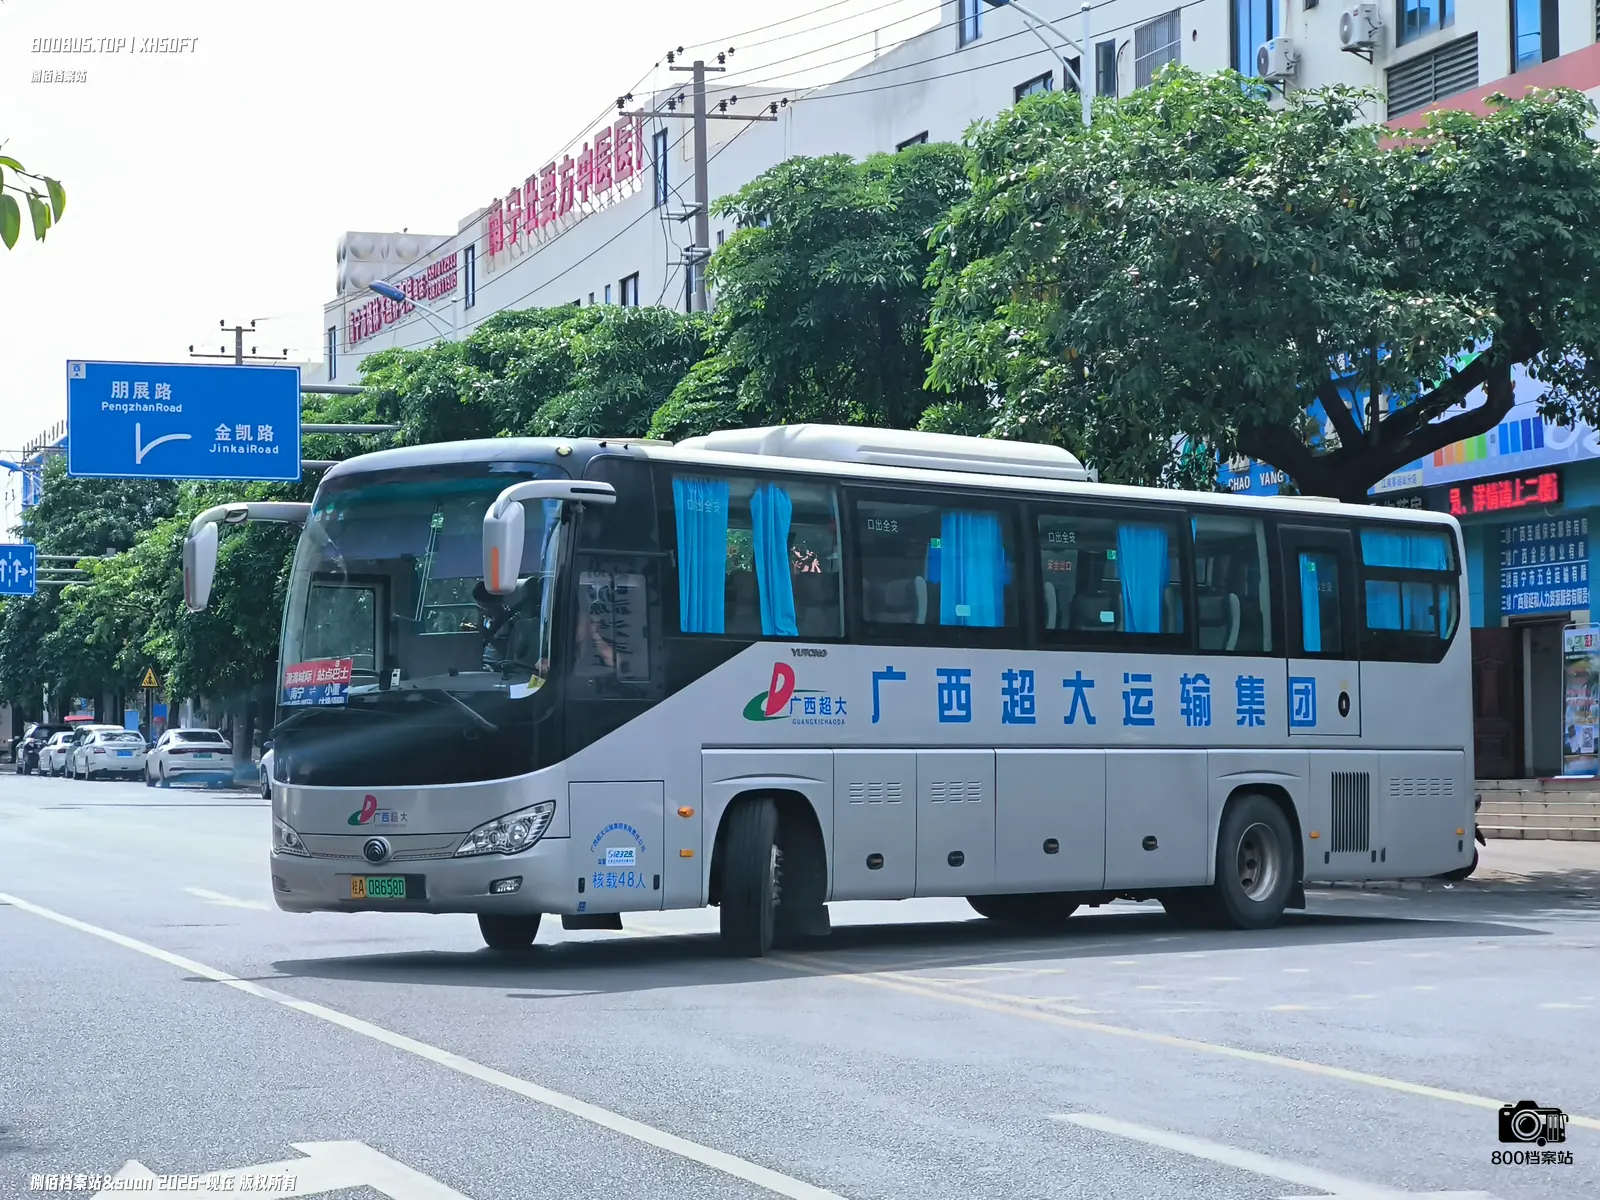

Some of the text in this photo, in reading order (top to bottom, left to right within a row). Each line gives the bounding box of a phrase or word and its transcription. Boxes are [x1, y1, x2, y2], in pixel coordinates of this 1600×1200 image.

[111, 381, 173, 401] 朋展路
[215, 423, 275, 442] 金凯路
[1228, 470, 1284, 491] CHAO YANG
[791, 648, 828, 658] YUTONG
[317, 667, 349, 681] 站点巴士
[290, 686, 305, 700] 南宁
[872, 666, 1317, 728] 广西超大运输集团
[789, 696, 847, 716] 广西超大
[373, 811, 408, 823] 广西超大
[592, 871, 646, 889] 核载48人
